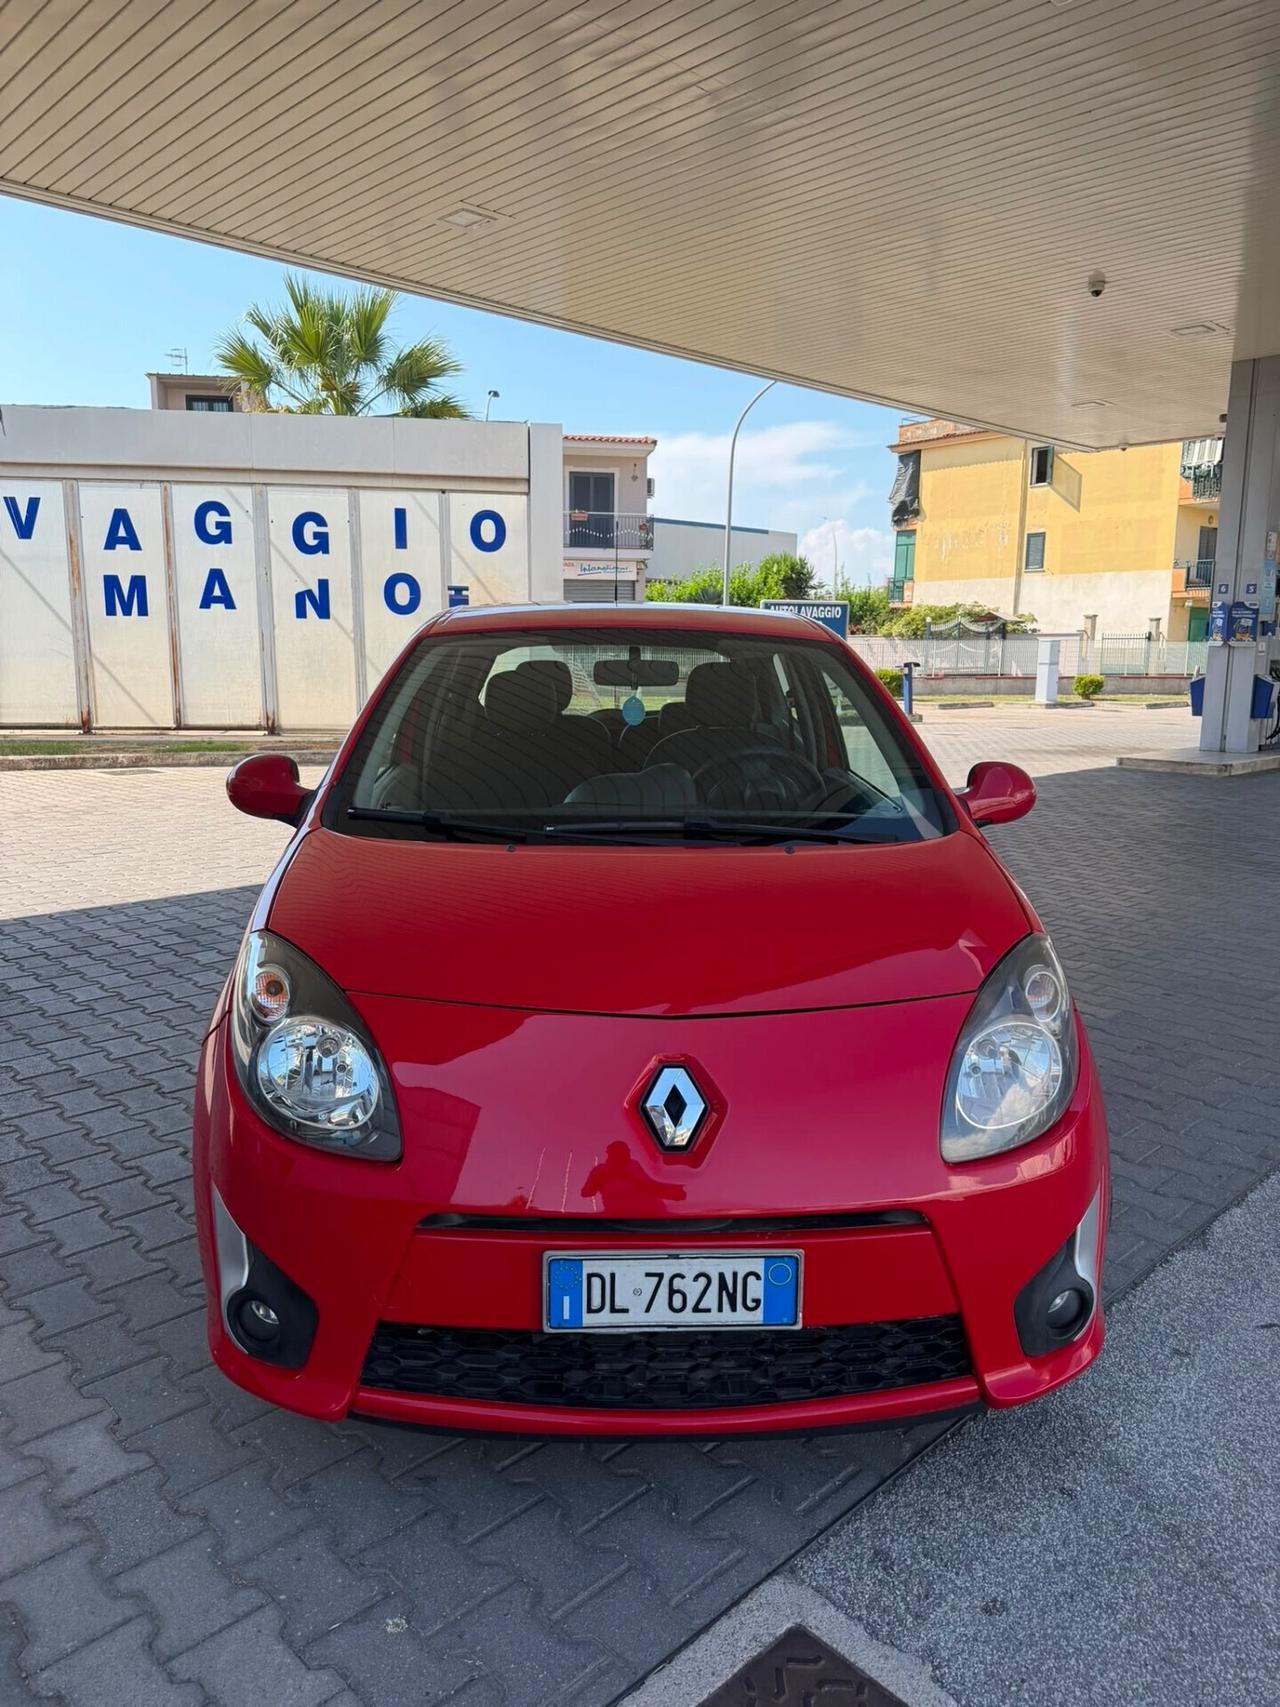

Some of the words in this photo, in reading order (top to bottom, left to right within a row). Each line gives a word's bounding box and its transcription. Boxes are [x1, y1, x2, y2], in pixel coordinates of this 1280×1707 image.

[3, 496, 507, 555] VAGGIO
[103, 568, 421, 620] MANO
[562, 1295, 570, 1320] I
